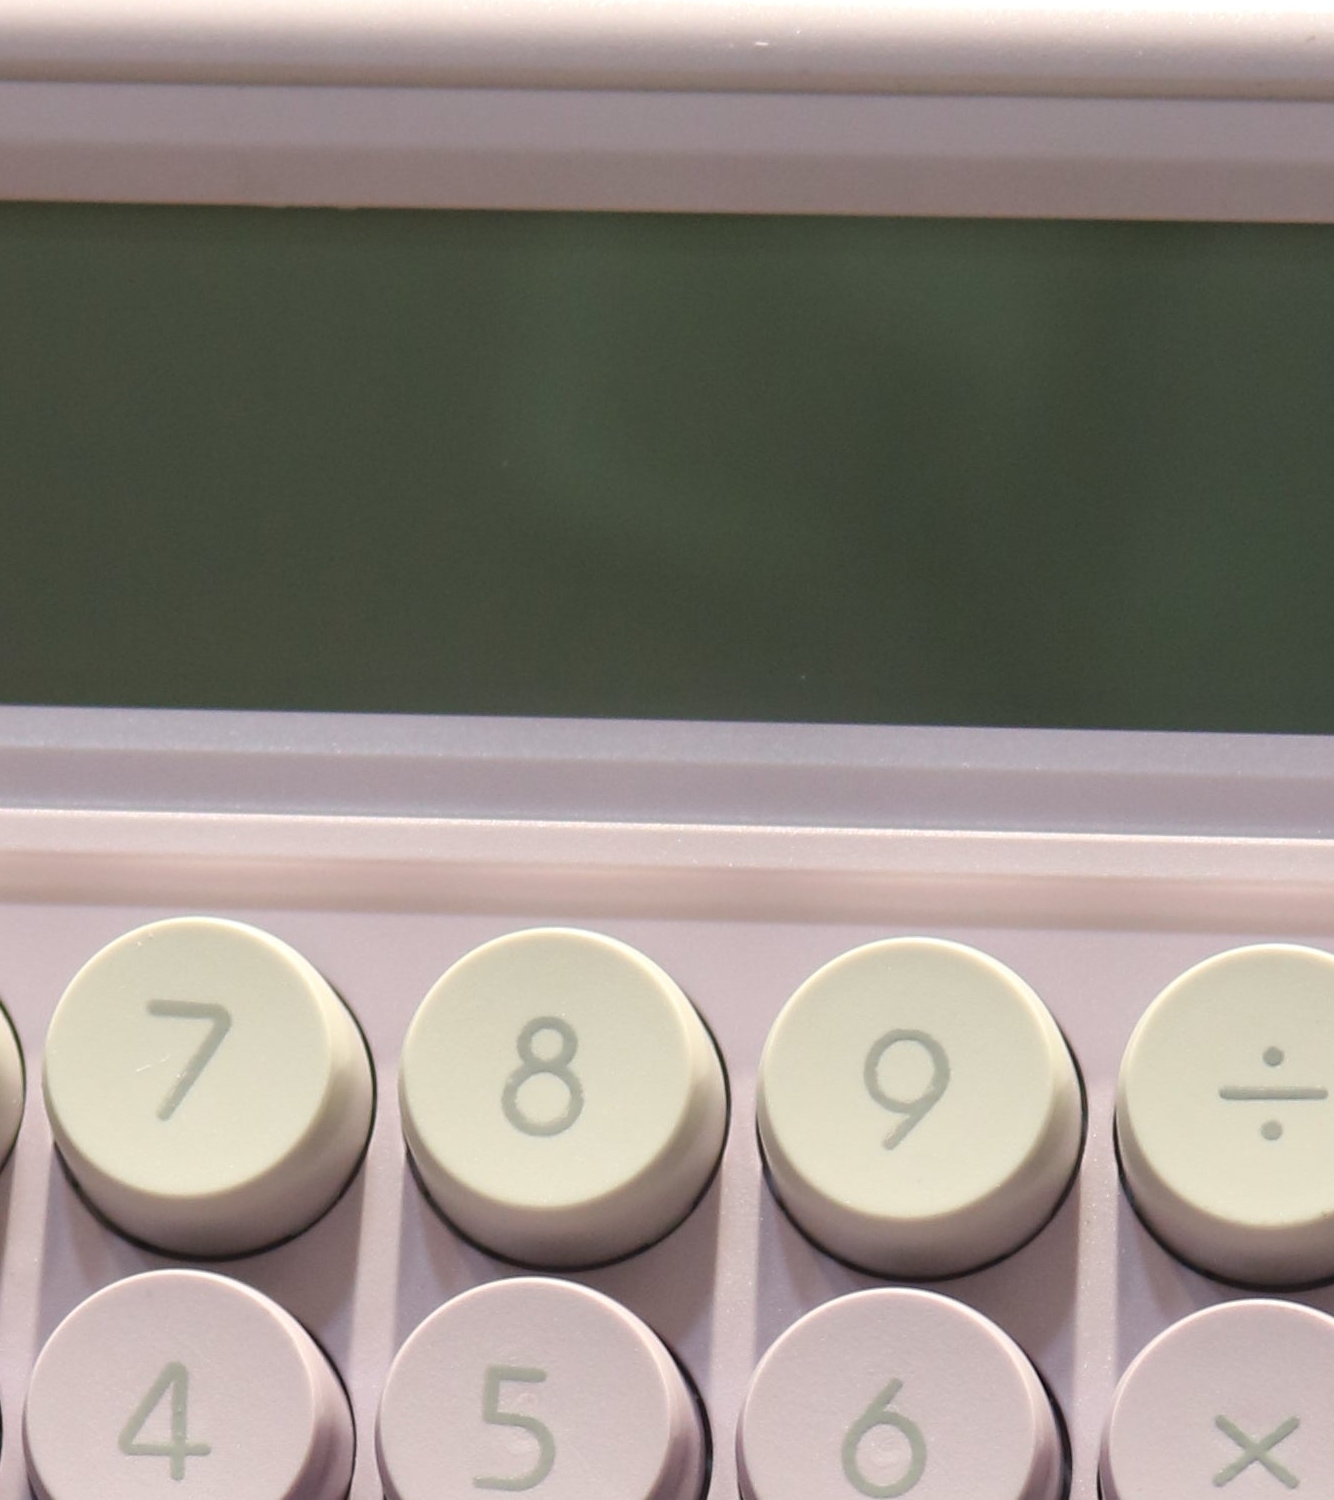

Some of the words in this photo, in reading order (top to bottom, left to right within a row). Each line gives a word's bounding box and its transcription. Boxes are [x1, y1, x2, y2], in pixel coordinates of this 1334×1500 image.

[145, 998, 234, 1121] 7
[500, 1014, 585, 1138] 8
[862, 1027, 952, 1151] 9
[117, 1360, 212, 1482] 4
[474, 1363, 557, 1493] 5
[840, 1376, 928, 1500] 6
